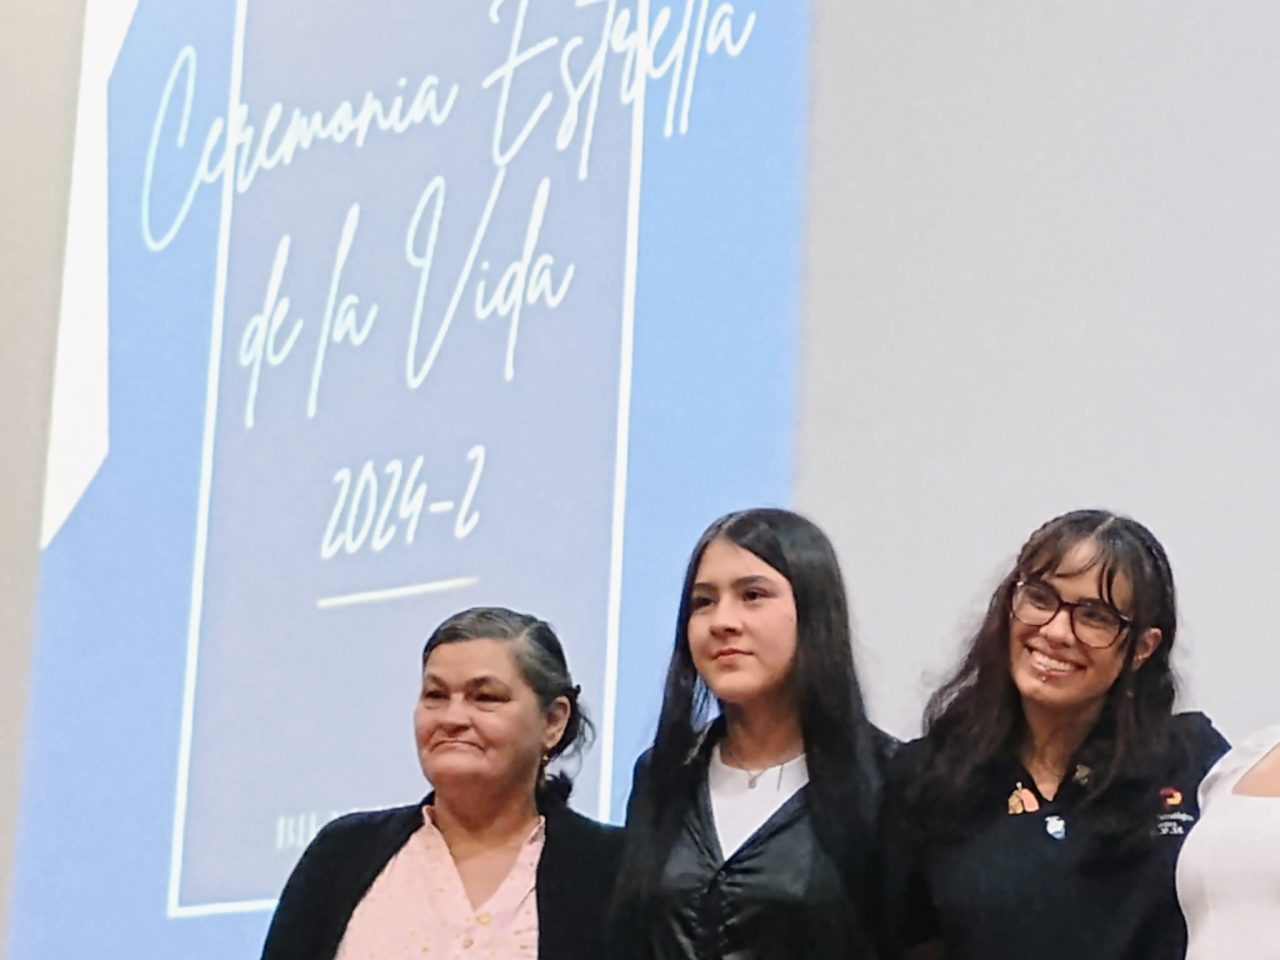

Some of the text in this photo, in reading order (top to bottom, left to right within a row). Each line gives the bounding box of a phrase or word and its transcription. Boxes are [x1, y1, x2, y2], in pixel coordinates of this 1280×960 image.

[141, 0, 758, 253] Ceremonia Estrella
[238, 167, 576, 430] de la Vida
[320, 444, 487, 560] 2024-2
